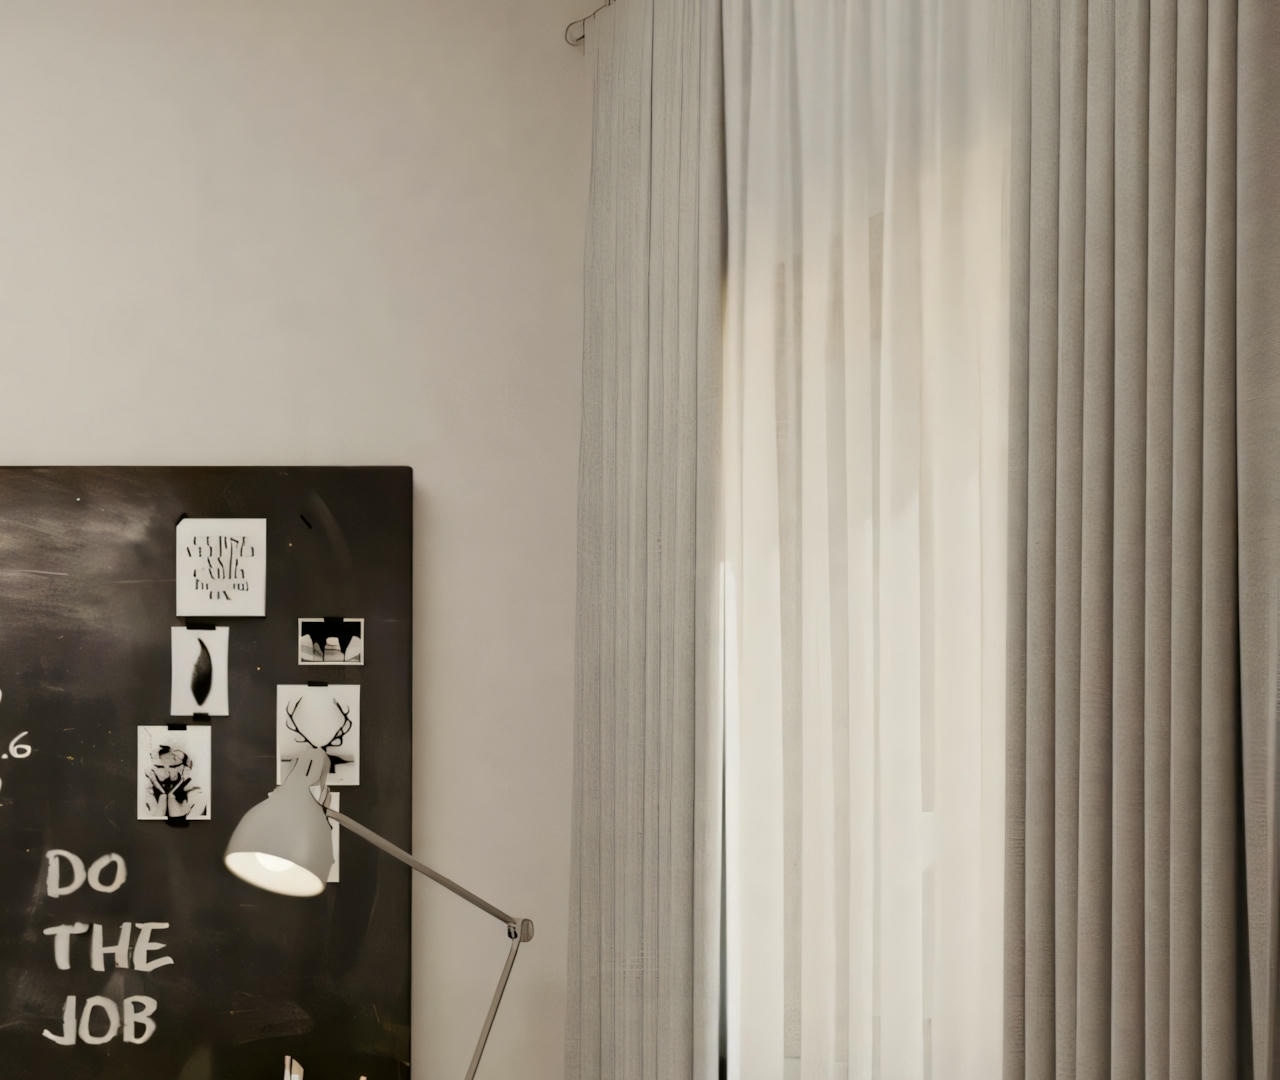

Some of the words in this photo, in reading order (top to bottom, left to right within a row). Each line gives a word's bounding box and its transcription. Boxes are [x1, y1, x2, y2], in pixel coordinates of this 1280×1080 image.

[45, 849, 128, 898] DO
[42, 921, 175, 973] THE
[42, 995, 158, 1046] JOB
